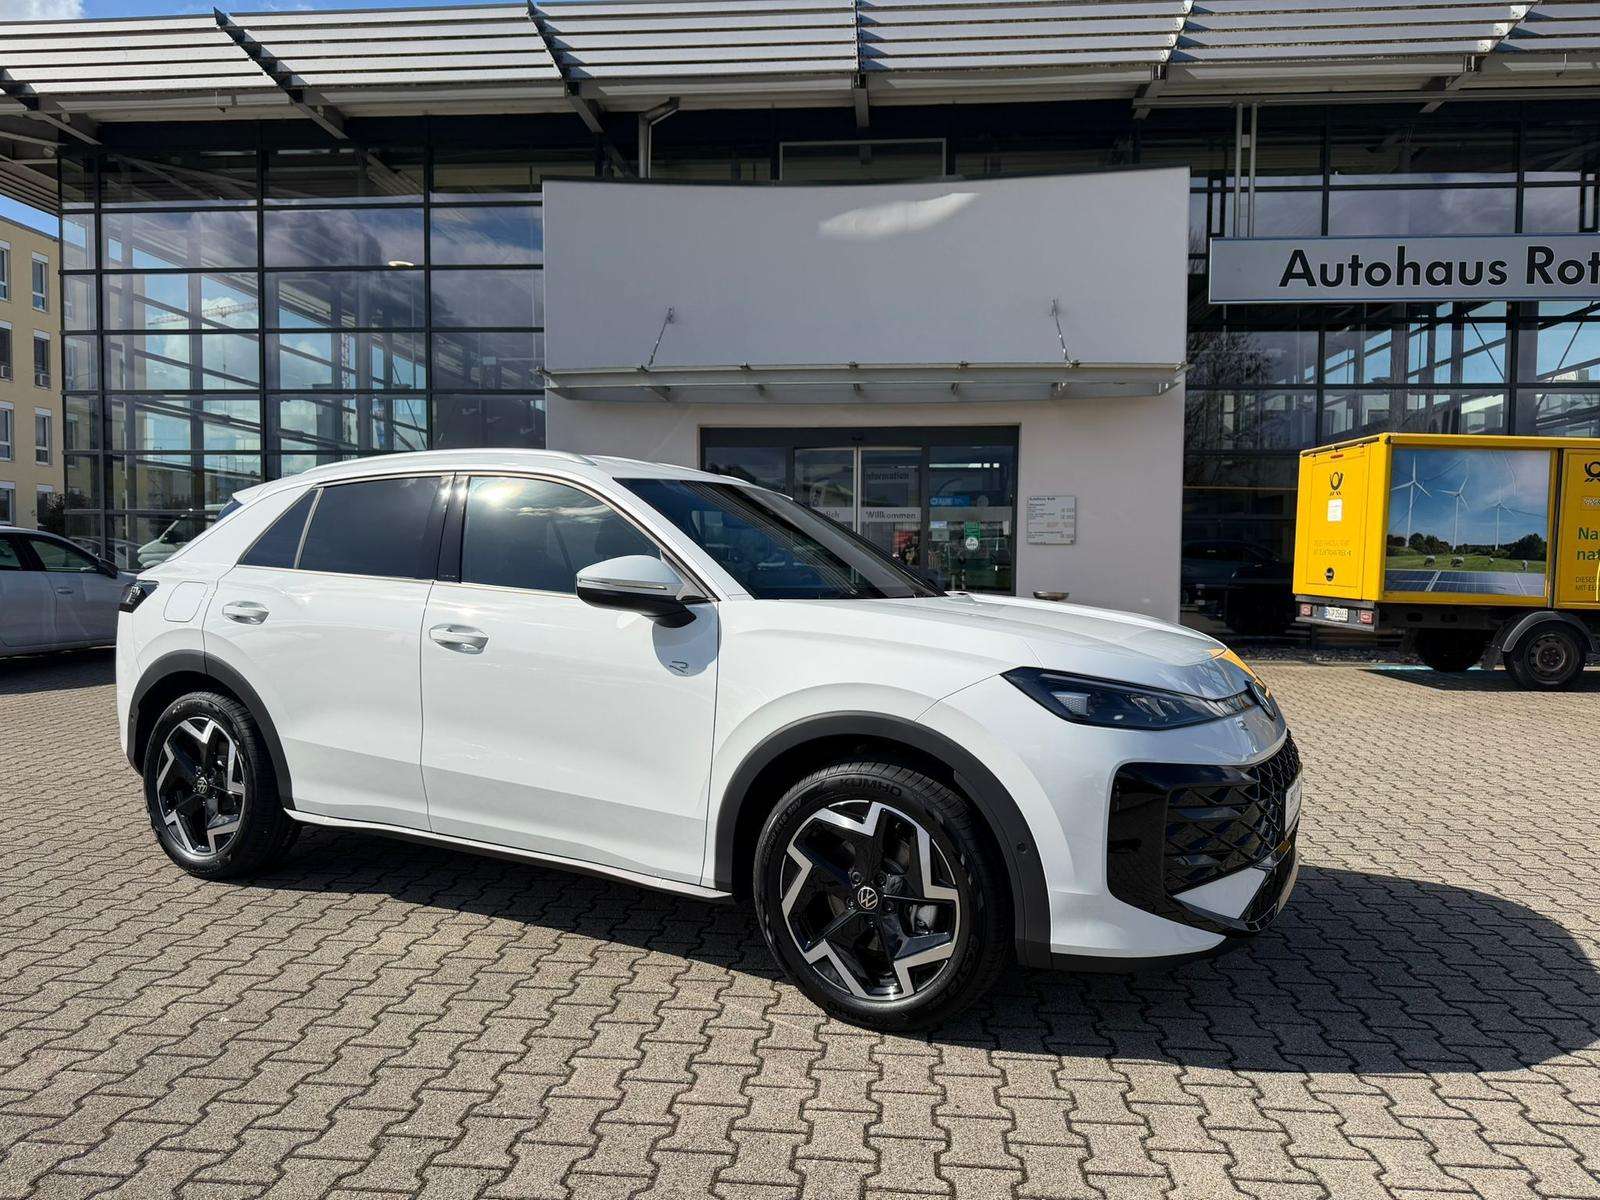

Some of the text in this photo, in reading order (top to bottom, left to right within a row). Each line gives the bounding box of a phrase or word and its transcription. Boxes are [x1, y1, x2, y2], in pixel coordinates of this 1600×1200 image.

[1278, 245, 1600, 288] Autohaus Rot
[865, 510, 917, 519] Willkommen
[839, 777, 902, 797] KUMHO
